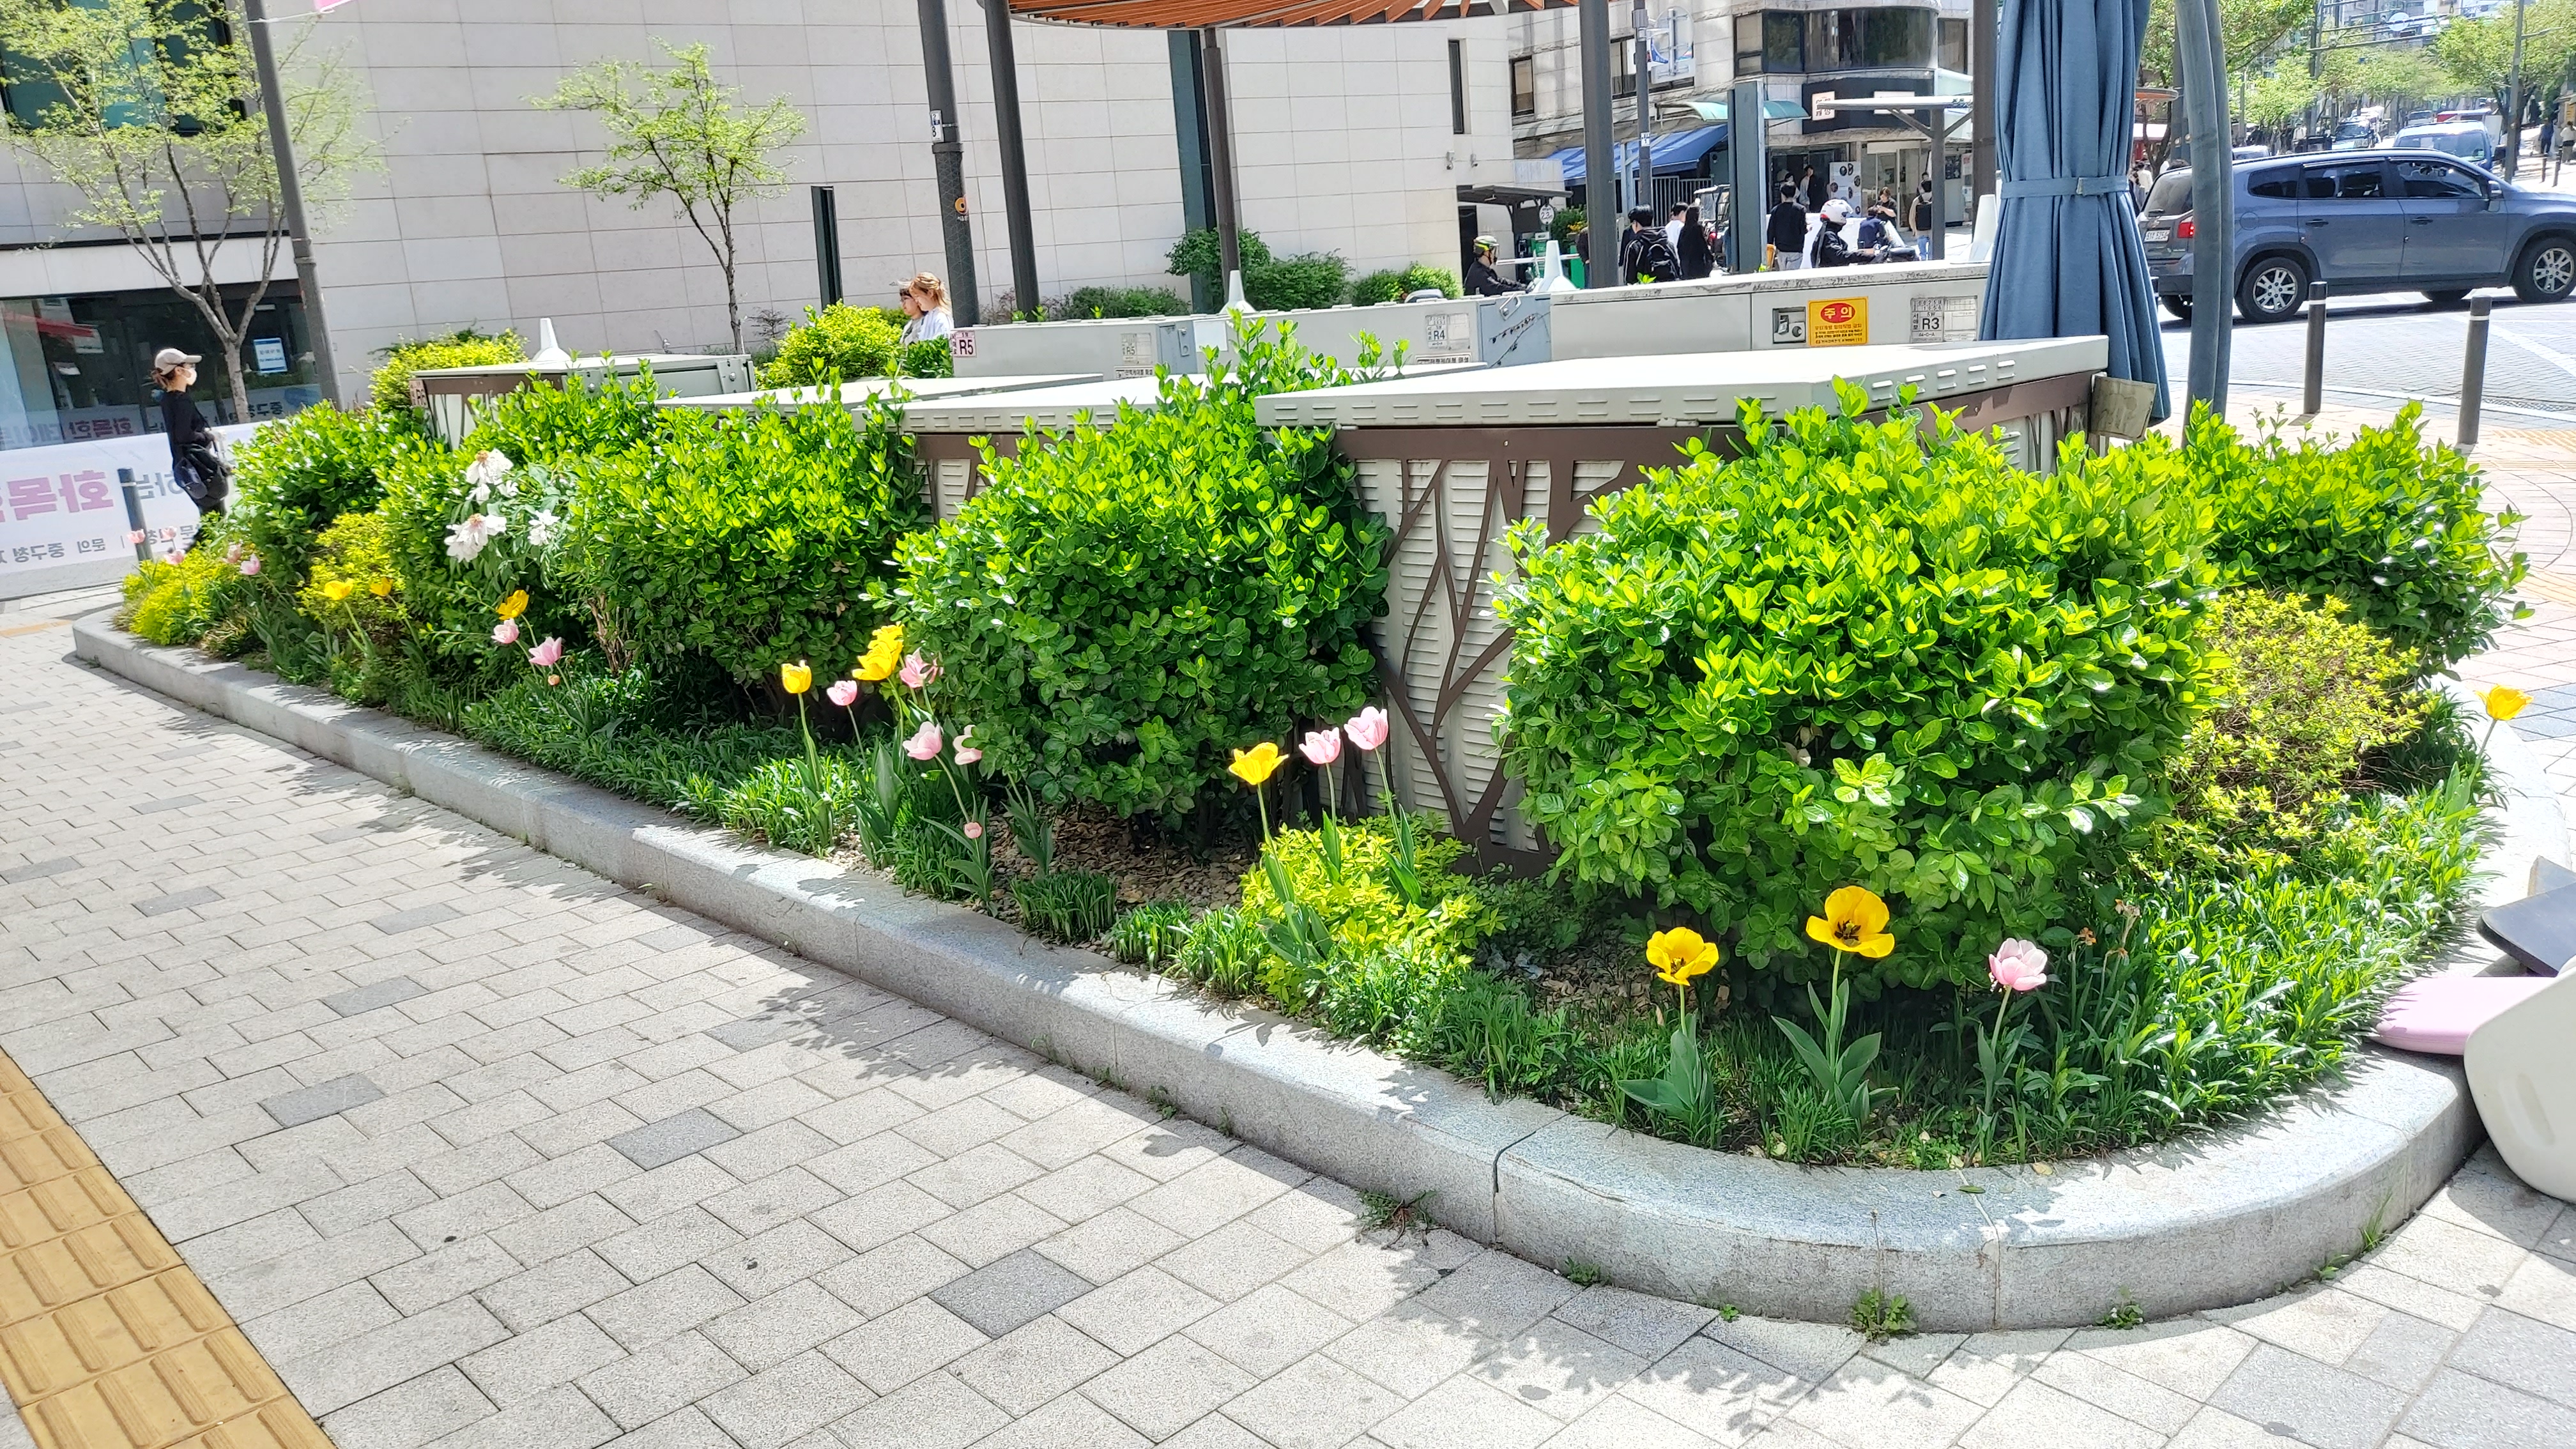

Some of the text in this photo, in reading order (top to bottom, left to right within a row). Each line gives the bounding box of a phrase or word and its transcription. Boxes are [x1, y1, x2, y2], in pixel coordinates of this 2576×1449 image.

[1824, 307, 1852, 319] 주의
[1922, 317, 1940, 330] R3
[1434, 330, 1446, 341] R4
[959, 339, 974, 355] R5
[1126, 346, 1135, 355] R5
